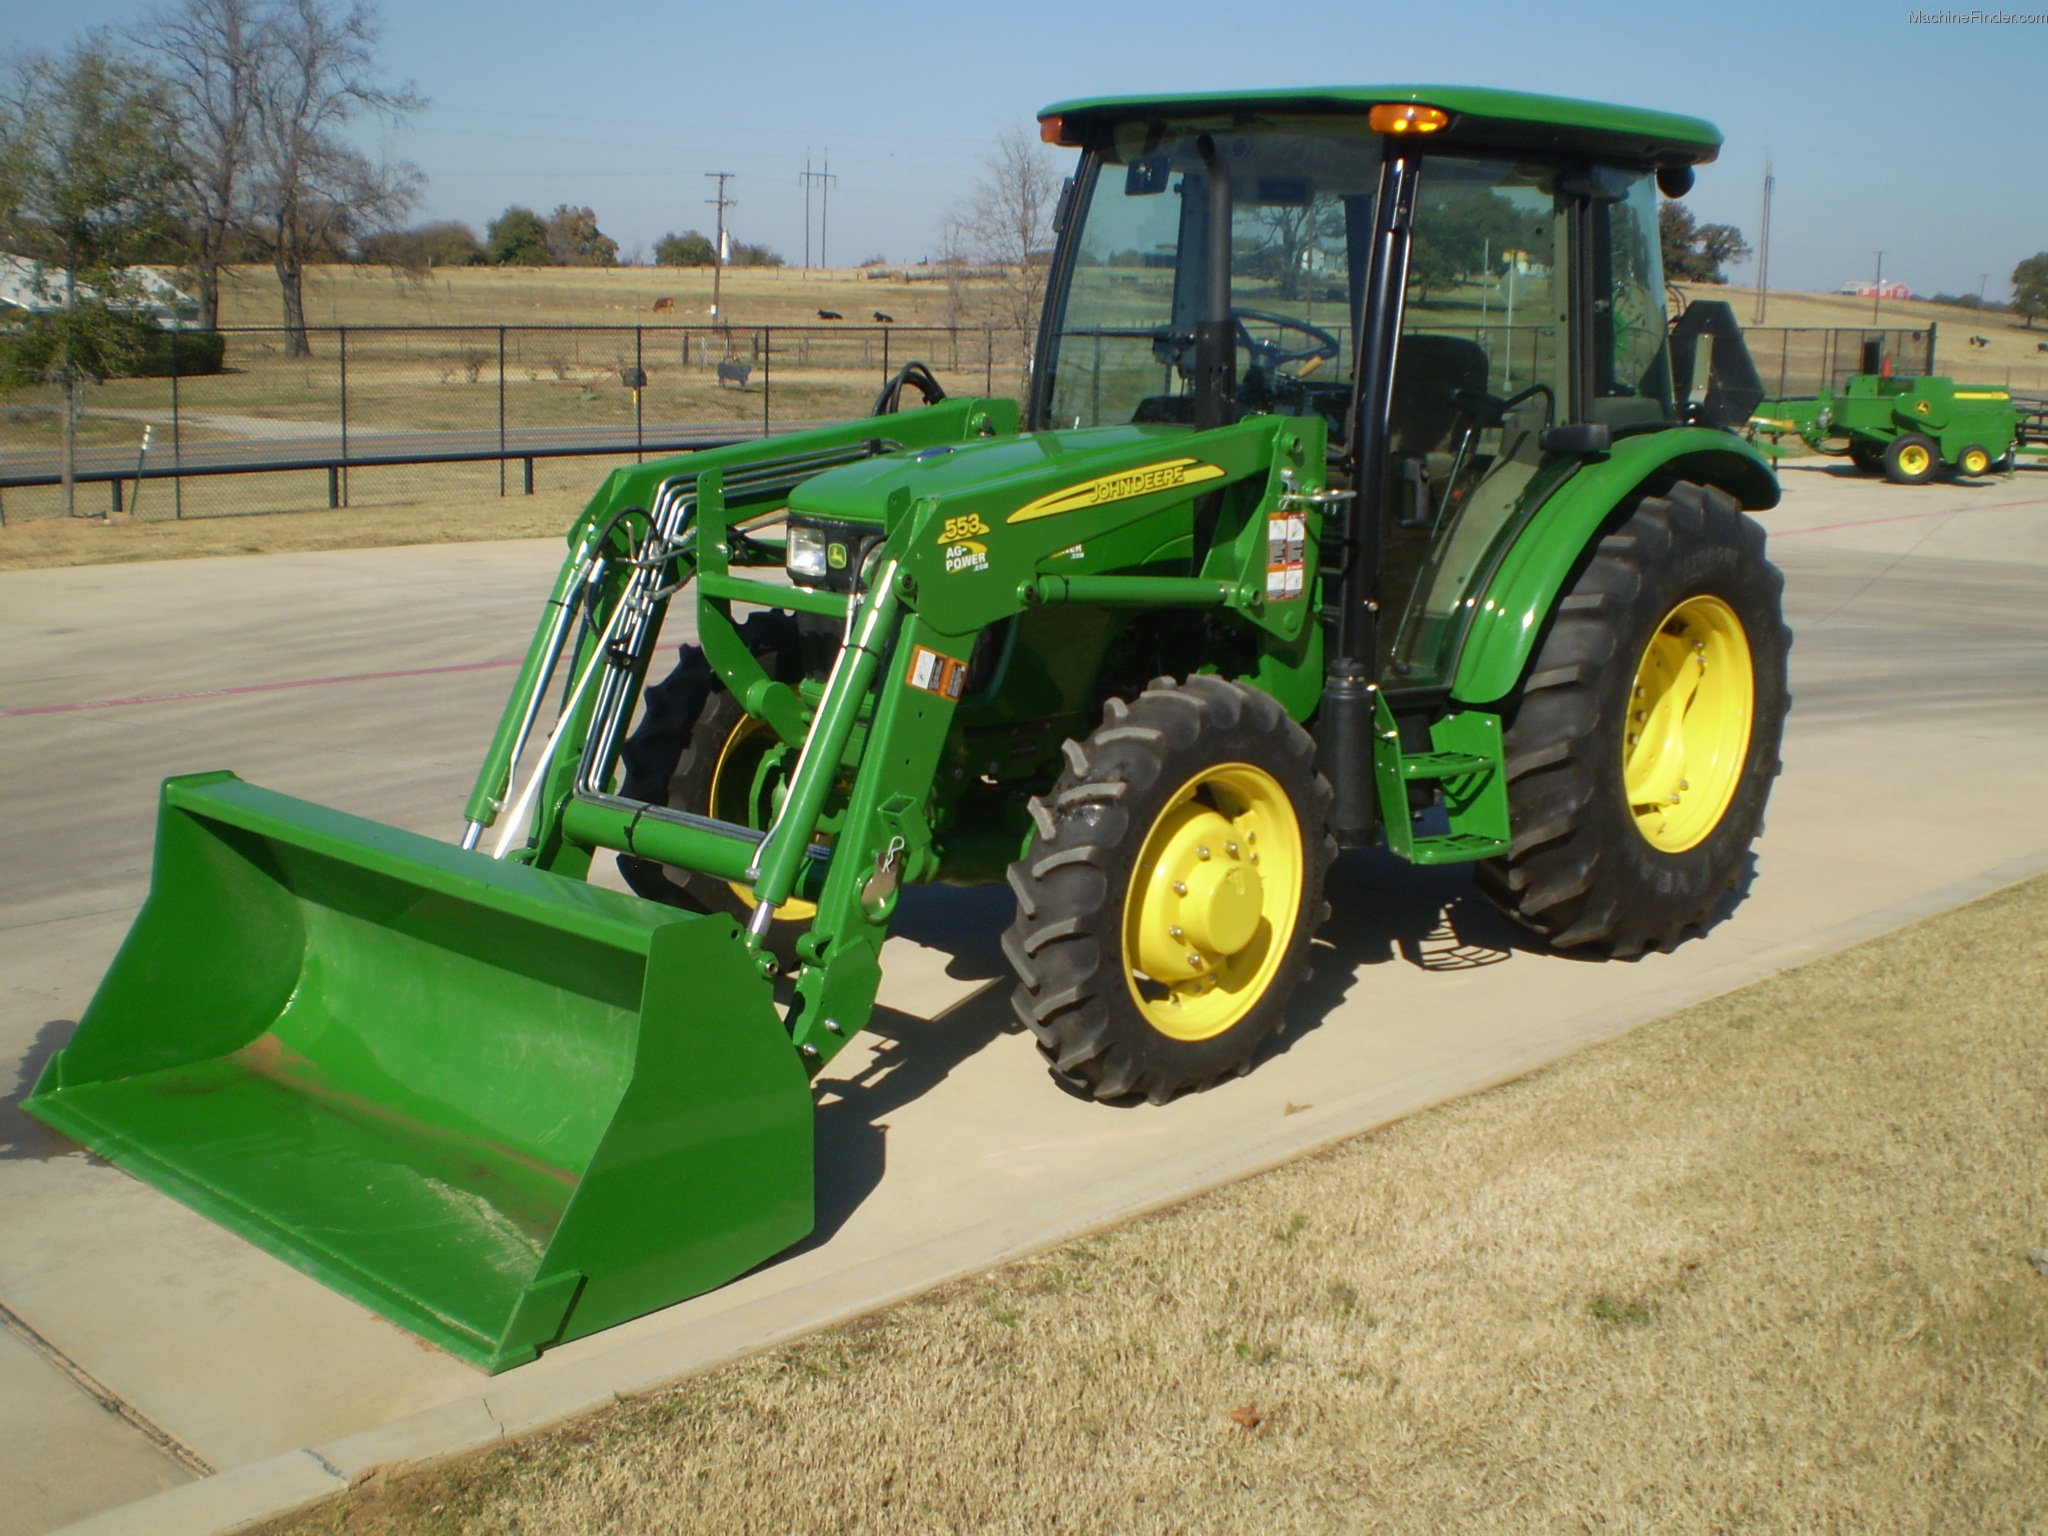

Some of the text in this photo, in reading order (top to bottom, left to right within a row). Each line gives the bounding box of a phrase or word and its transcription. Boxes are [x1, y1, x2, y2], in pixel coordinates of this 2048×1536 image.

[945, 513, 980, 538] 553
[945, 552, 986, 572] POWER
[946, 545, 968, 559] AG-
